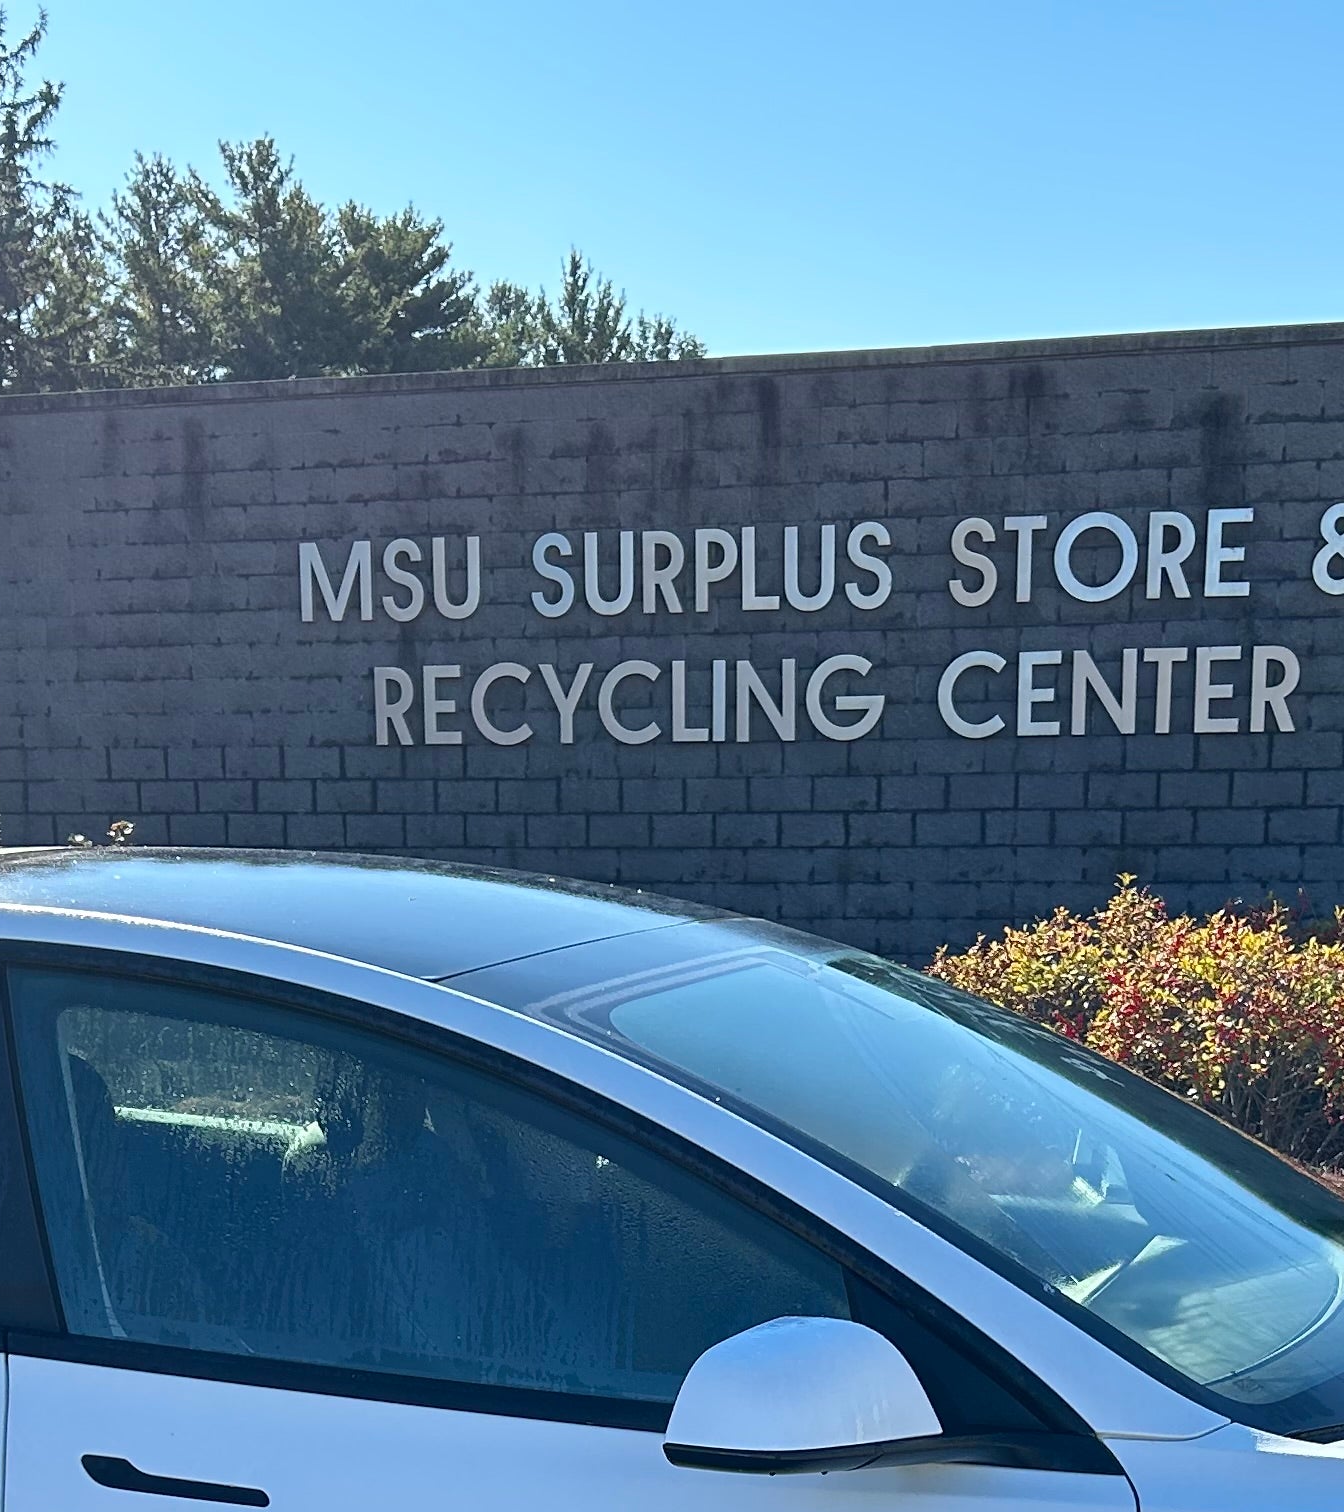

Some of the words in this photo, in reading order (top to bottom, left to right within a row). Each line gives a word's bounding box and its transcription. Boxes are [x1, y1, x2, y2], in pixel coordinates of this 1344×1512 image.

[298, 536, 482, 623] MSU
[530, 521, 894, 618] SURPLUS
[946, 507, 1254, 608] STORE
[373, 654, 886, 746] RECYCLING
[936, 645, 1301, 741] CENTER
